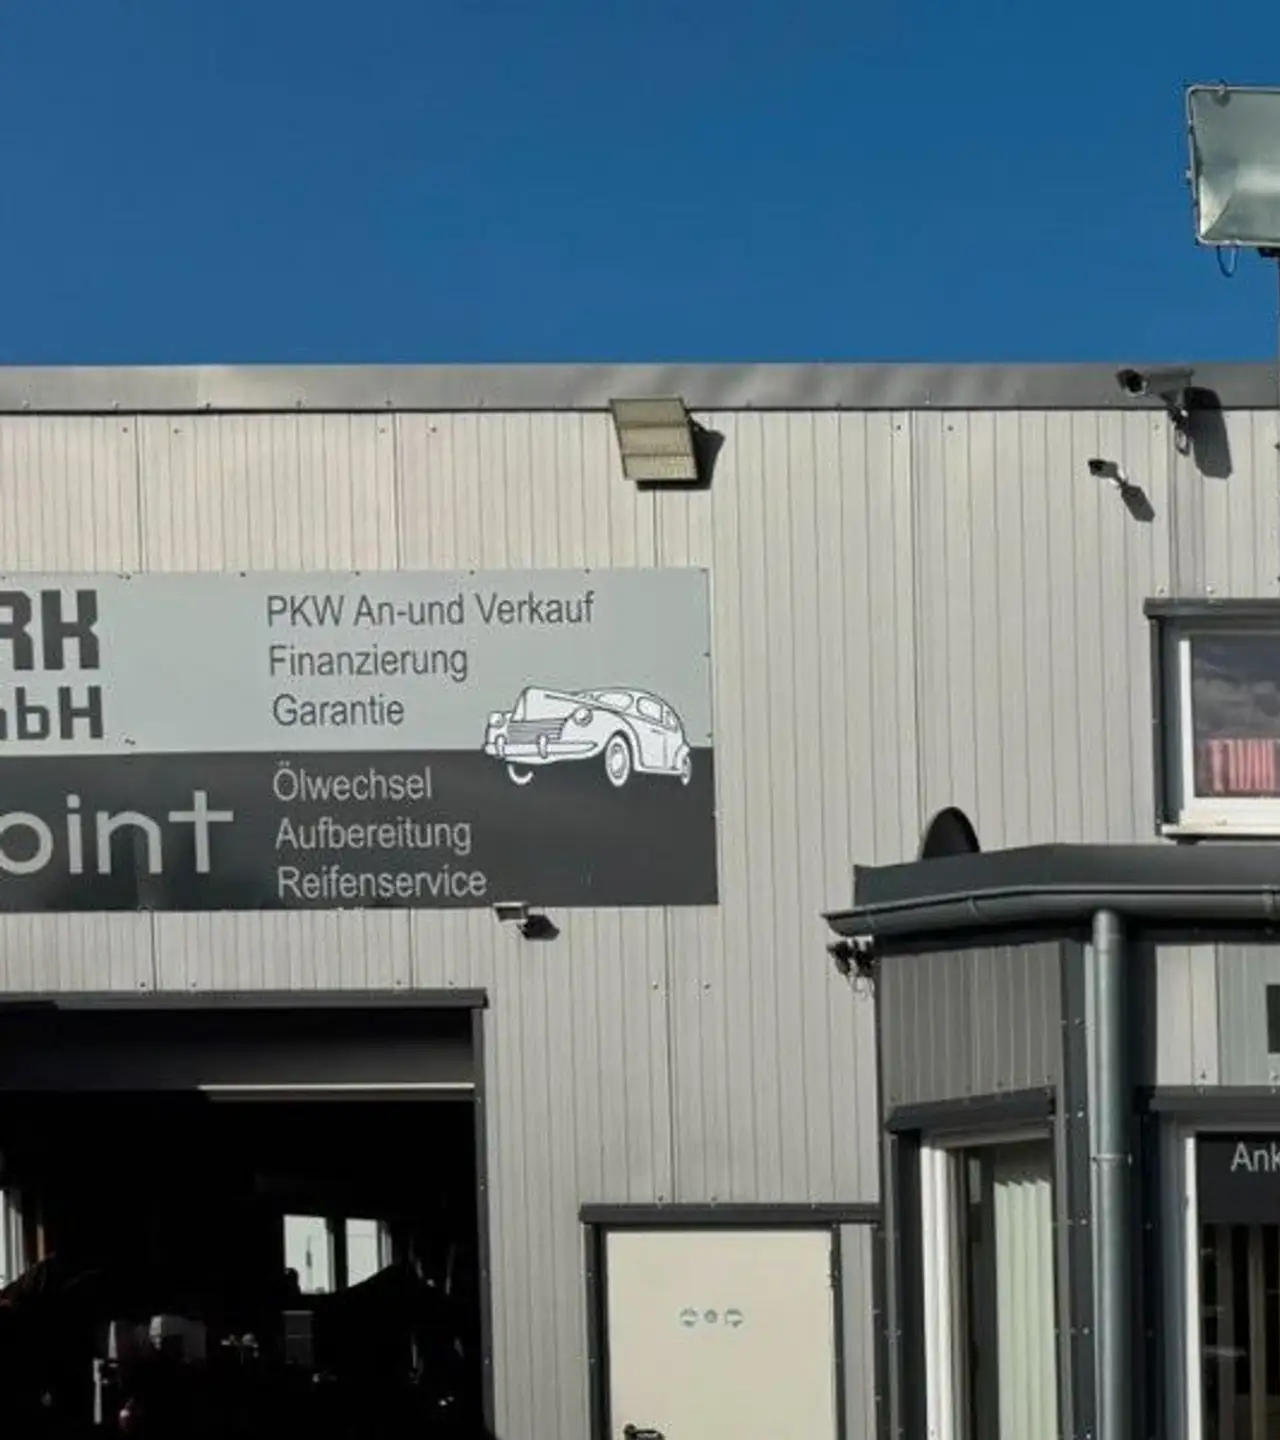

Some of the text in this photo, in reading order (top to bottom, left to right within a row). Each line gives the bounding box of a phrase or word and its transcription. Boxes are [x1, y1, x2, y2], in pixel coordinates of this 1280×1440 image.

[267, 590, 596, 628] PKW An-und Verkauf
[268, 643, 469, 683] Finanzierung
[0, 686, 104, 741] bH
[272, 693, 406, 727] Garantie
[272, 760, 433, 801] Ölwechsel
[275, 816, 473, 856] Aufbereitung
[277, 863, 489, 899] Reifenservice
